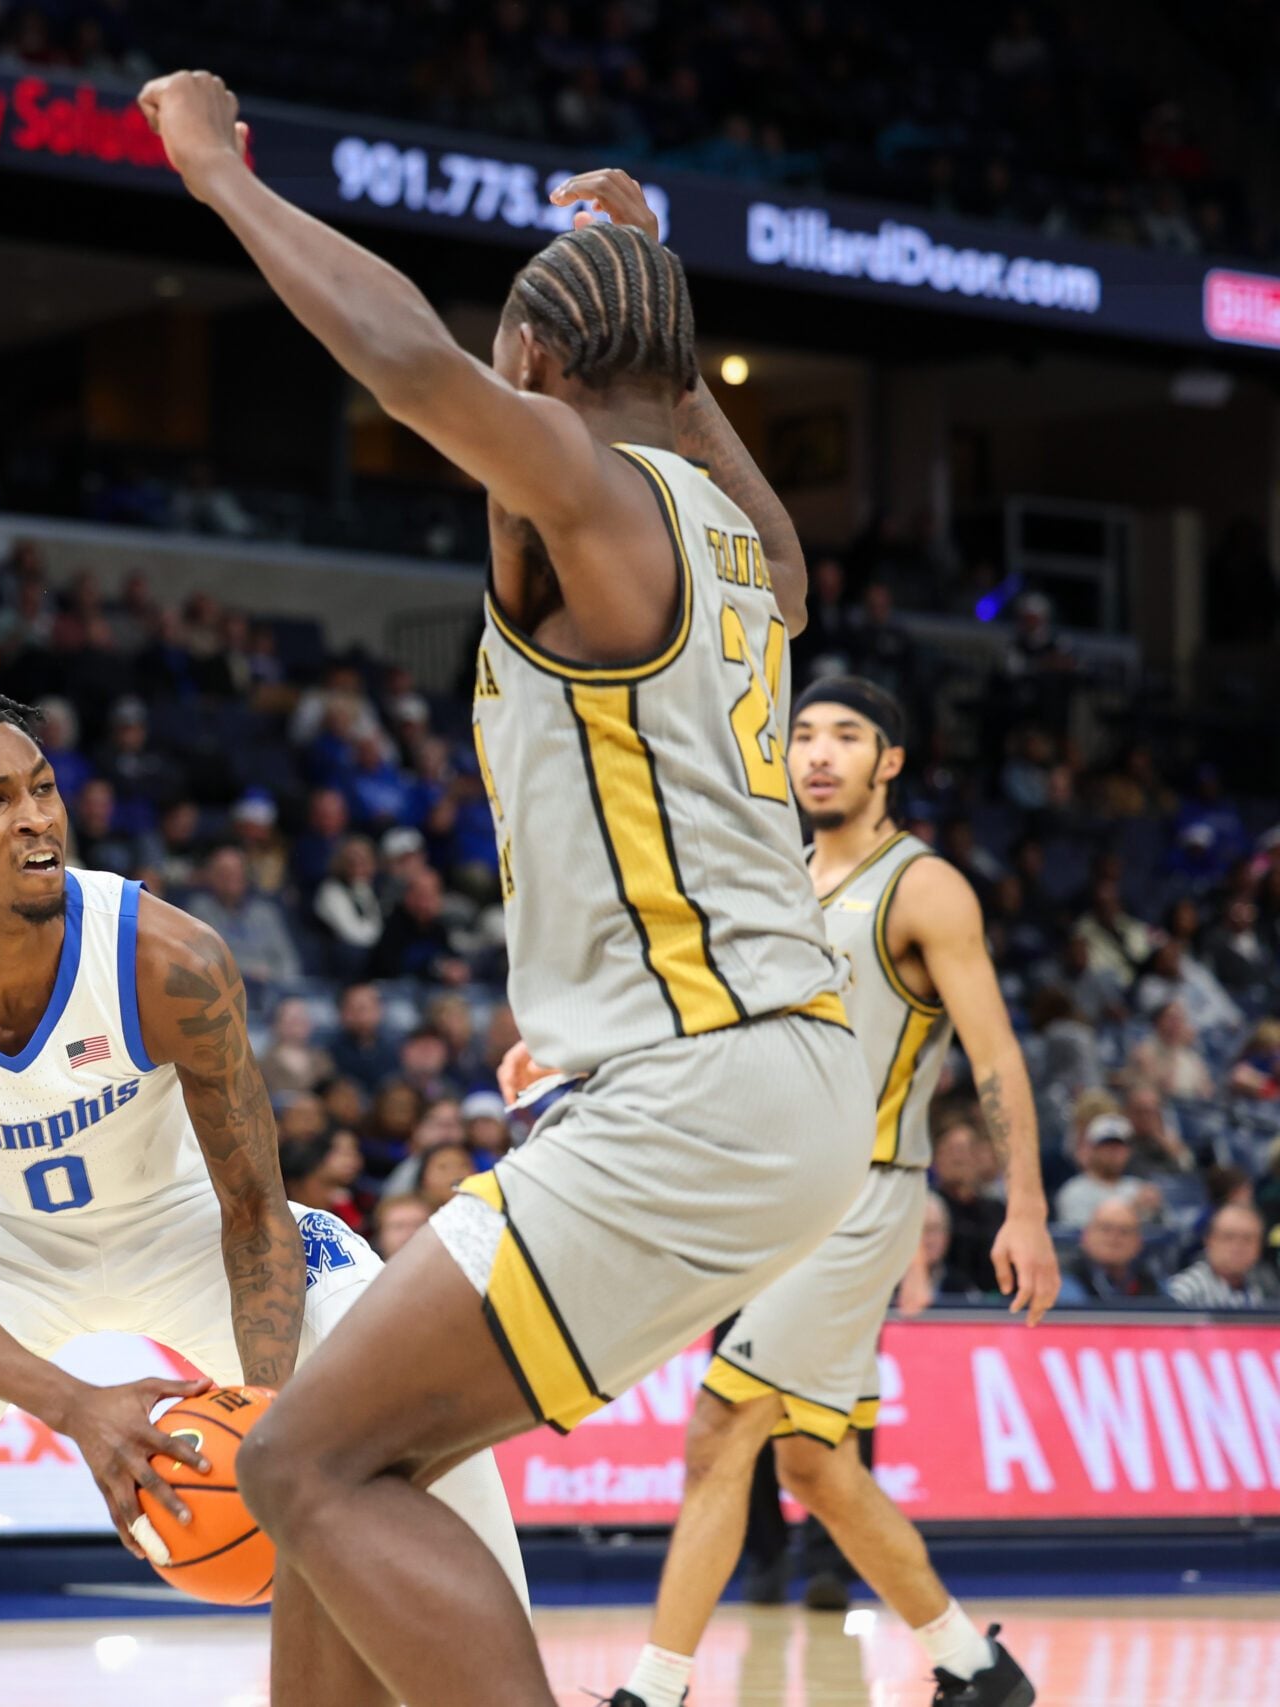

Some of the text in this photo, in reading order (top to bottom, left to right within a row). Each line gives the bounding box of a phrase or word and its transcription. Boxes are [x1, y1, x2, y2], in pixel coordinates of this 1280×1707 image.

[12, 76, 253, 172] Solut
[747, 202, 1102, 314] DillardDoor.com
[22, 1155, 94, 1213] 0
[973, 1347, 1056, 1492] A
